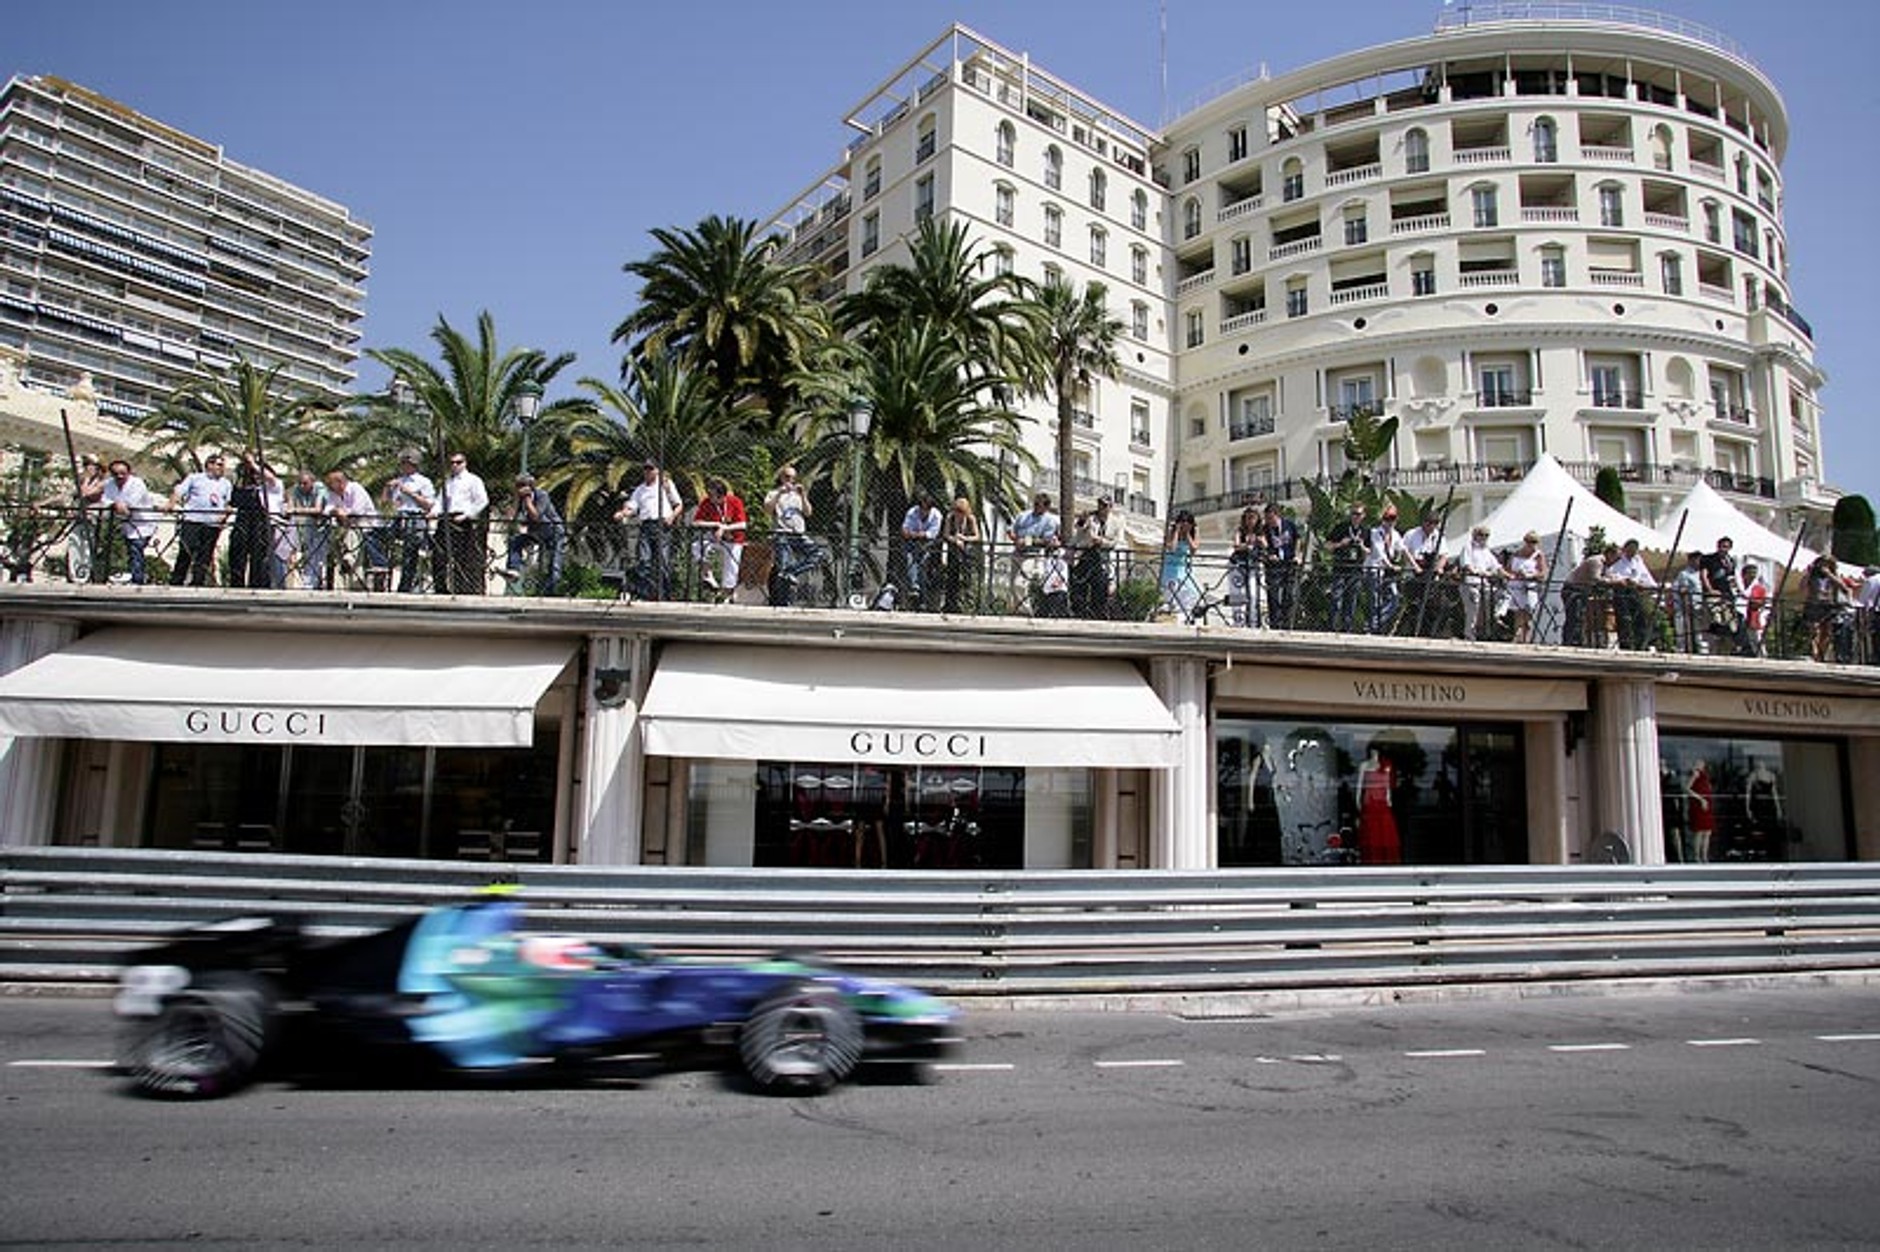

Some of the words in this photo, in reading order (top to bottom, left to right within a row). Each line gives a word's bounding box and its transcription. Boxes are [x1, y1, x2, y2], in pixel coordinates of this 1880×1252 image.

[1353, 681, 1466, 702] VALENTINO
[1743, 699, 1830, 719] VALENTINO
[186, 709, 325, 736] GUCCI
[850, 731, 985, 757] GUCCI
